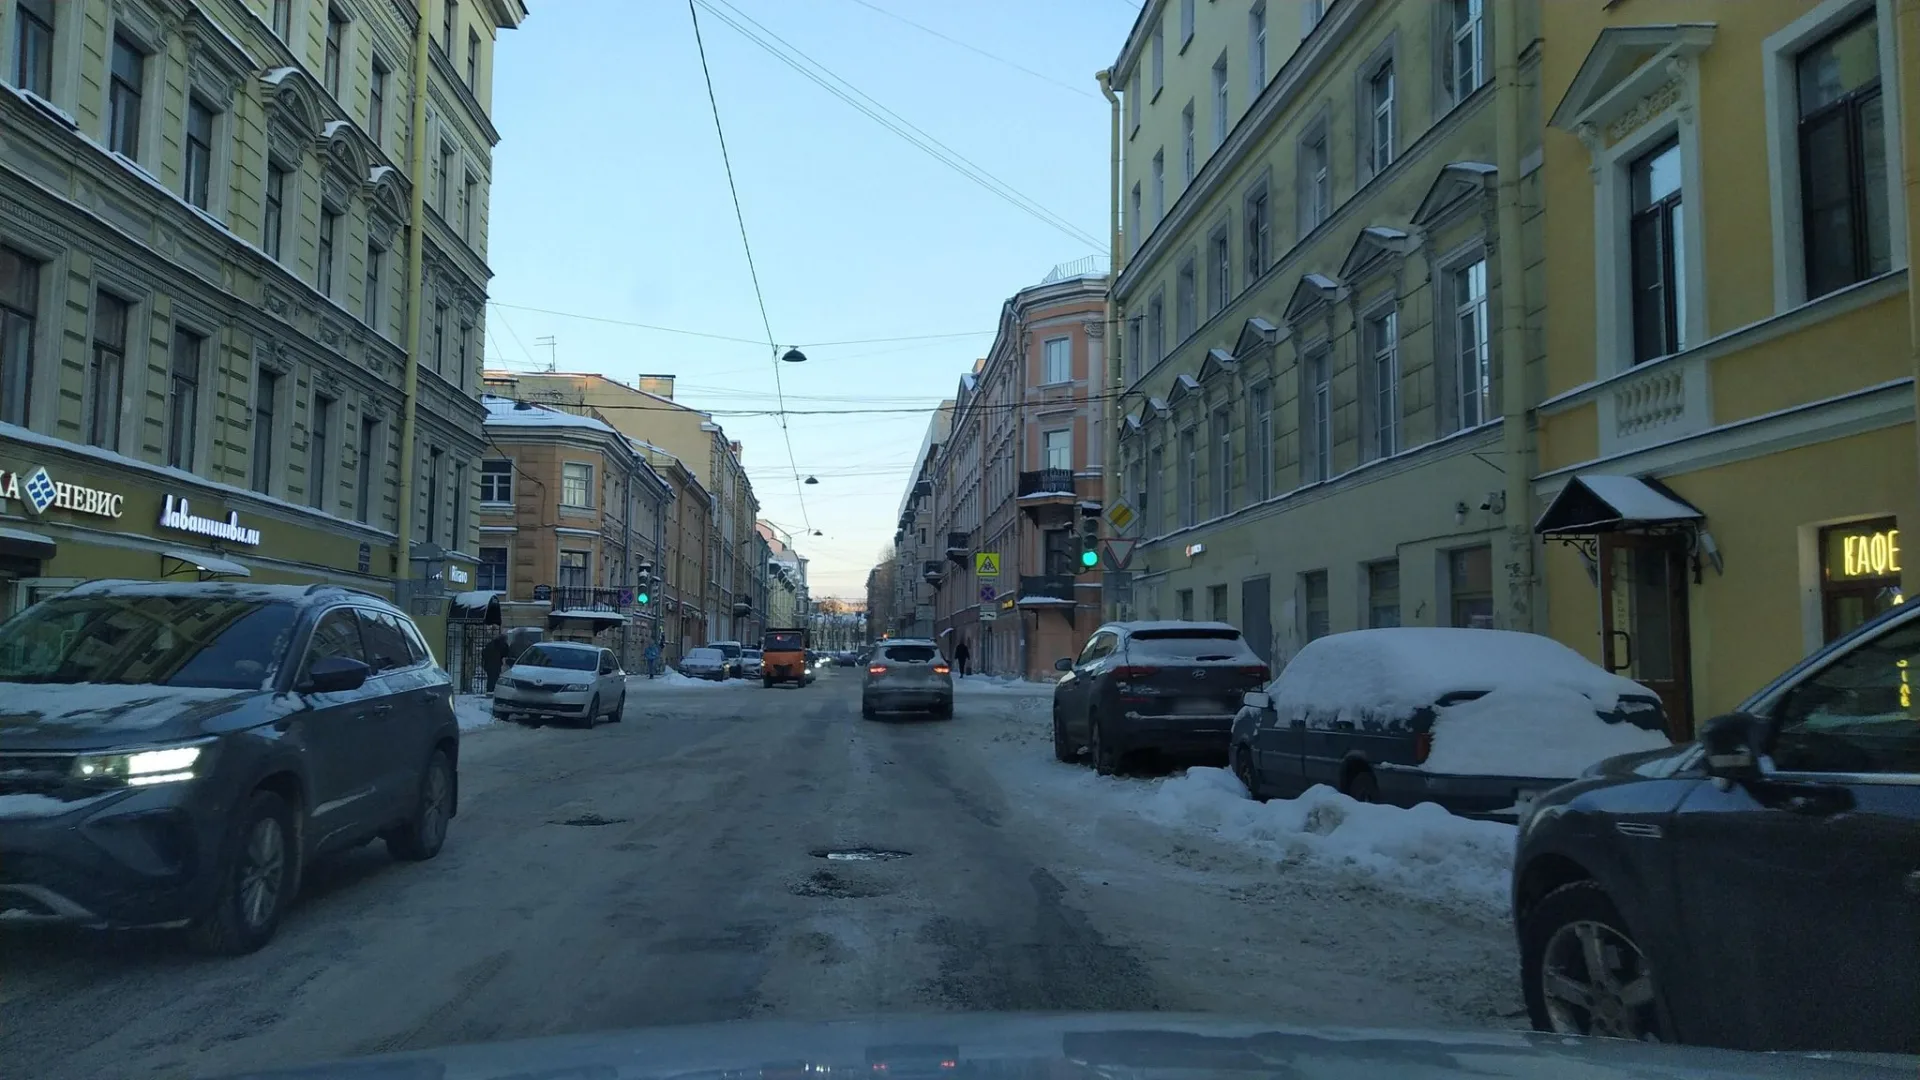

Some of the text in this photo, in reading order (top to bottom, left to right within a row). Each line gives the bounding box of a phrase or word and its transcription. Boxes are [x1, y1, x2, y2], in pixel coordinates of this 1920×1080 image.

[54, 481, 124, 518] НЕВИС
[160, 494, 260, 546] Лавашишвили
[1844, 530, 1902, 576] КАФЕ
